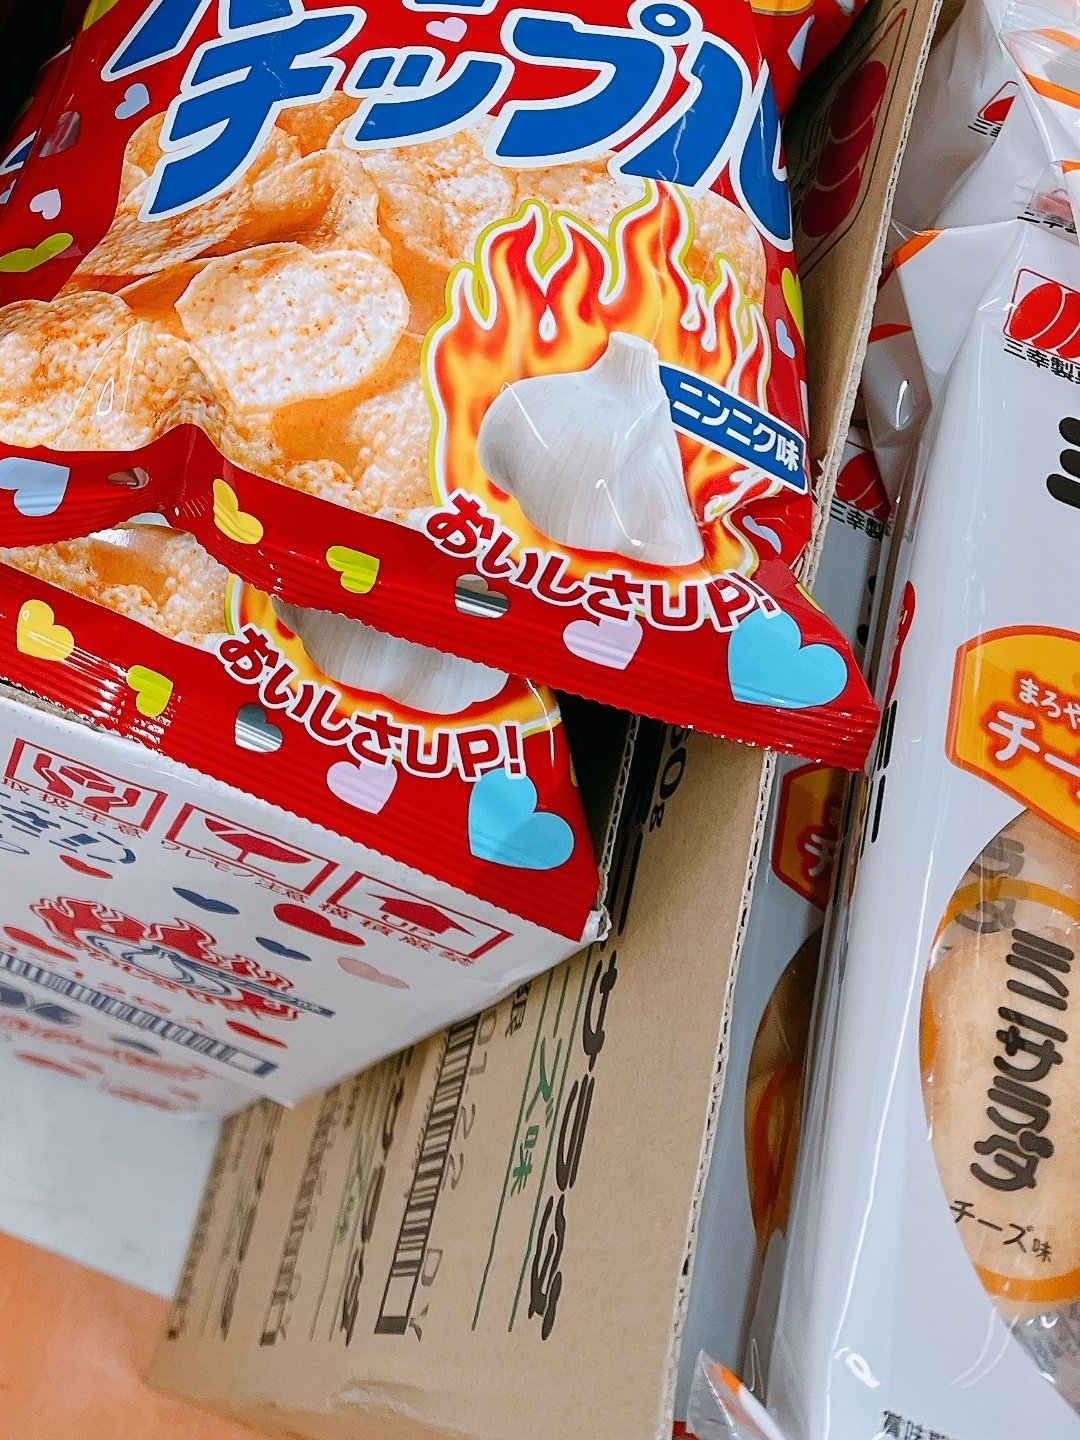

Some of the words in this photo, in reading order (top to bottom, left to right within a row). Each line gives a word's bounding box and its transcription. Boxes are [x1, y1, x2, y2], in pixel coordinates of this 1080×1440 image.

[671, 377, 800, 472] ニンニク味
[422, 488, 783, 633] おいしさUP!
[216, 625, 527, 782] おいしさUP!
[970, 928, 1075, 1192] ミニサラダ
[949, 1200, 1054, 1263] チーズ味
